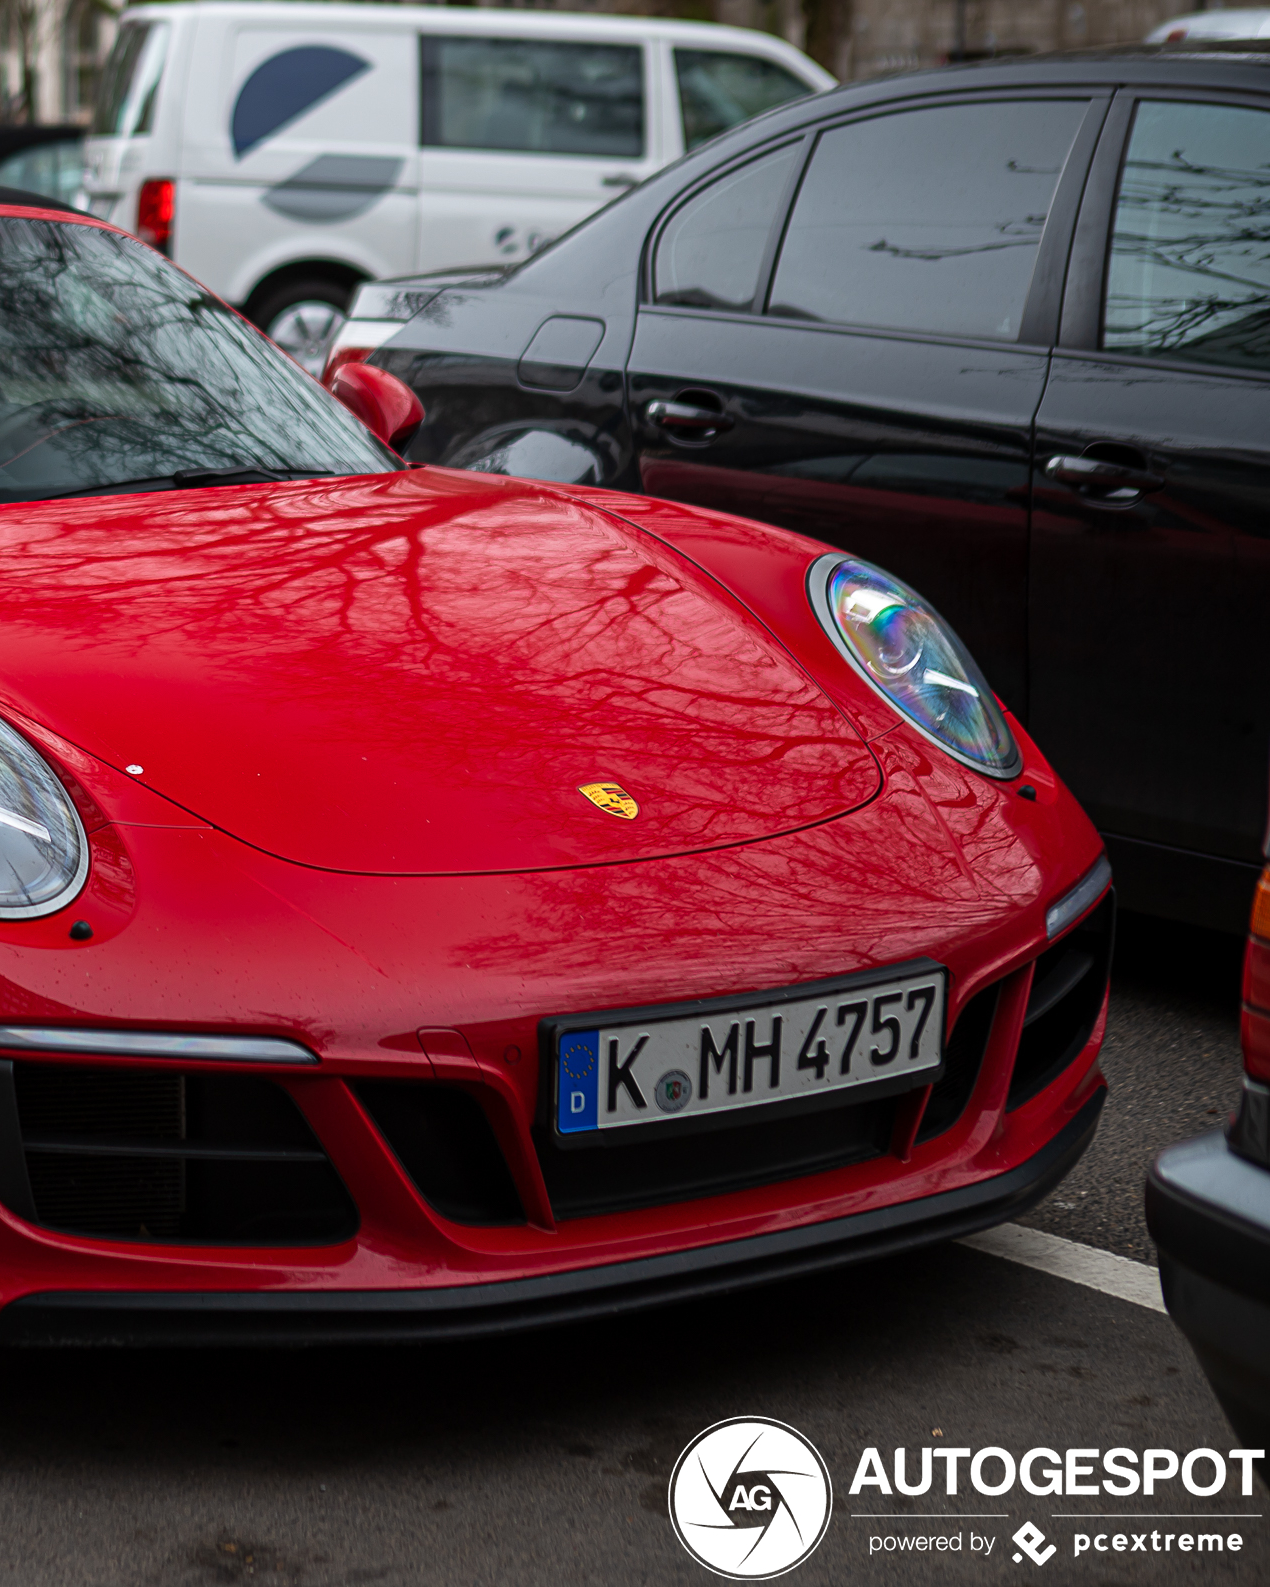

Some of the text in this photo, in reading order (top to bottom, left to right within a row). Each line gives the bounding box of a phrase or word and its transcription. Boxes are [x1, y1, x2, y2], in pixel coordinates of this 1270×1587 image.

[606, 983, 936, 1113] K MH 4757
[570, 1091, 585, 1113] D
